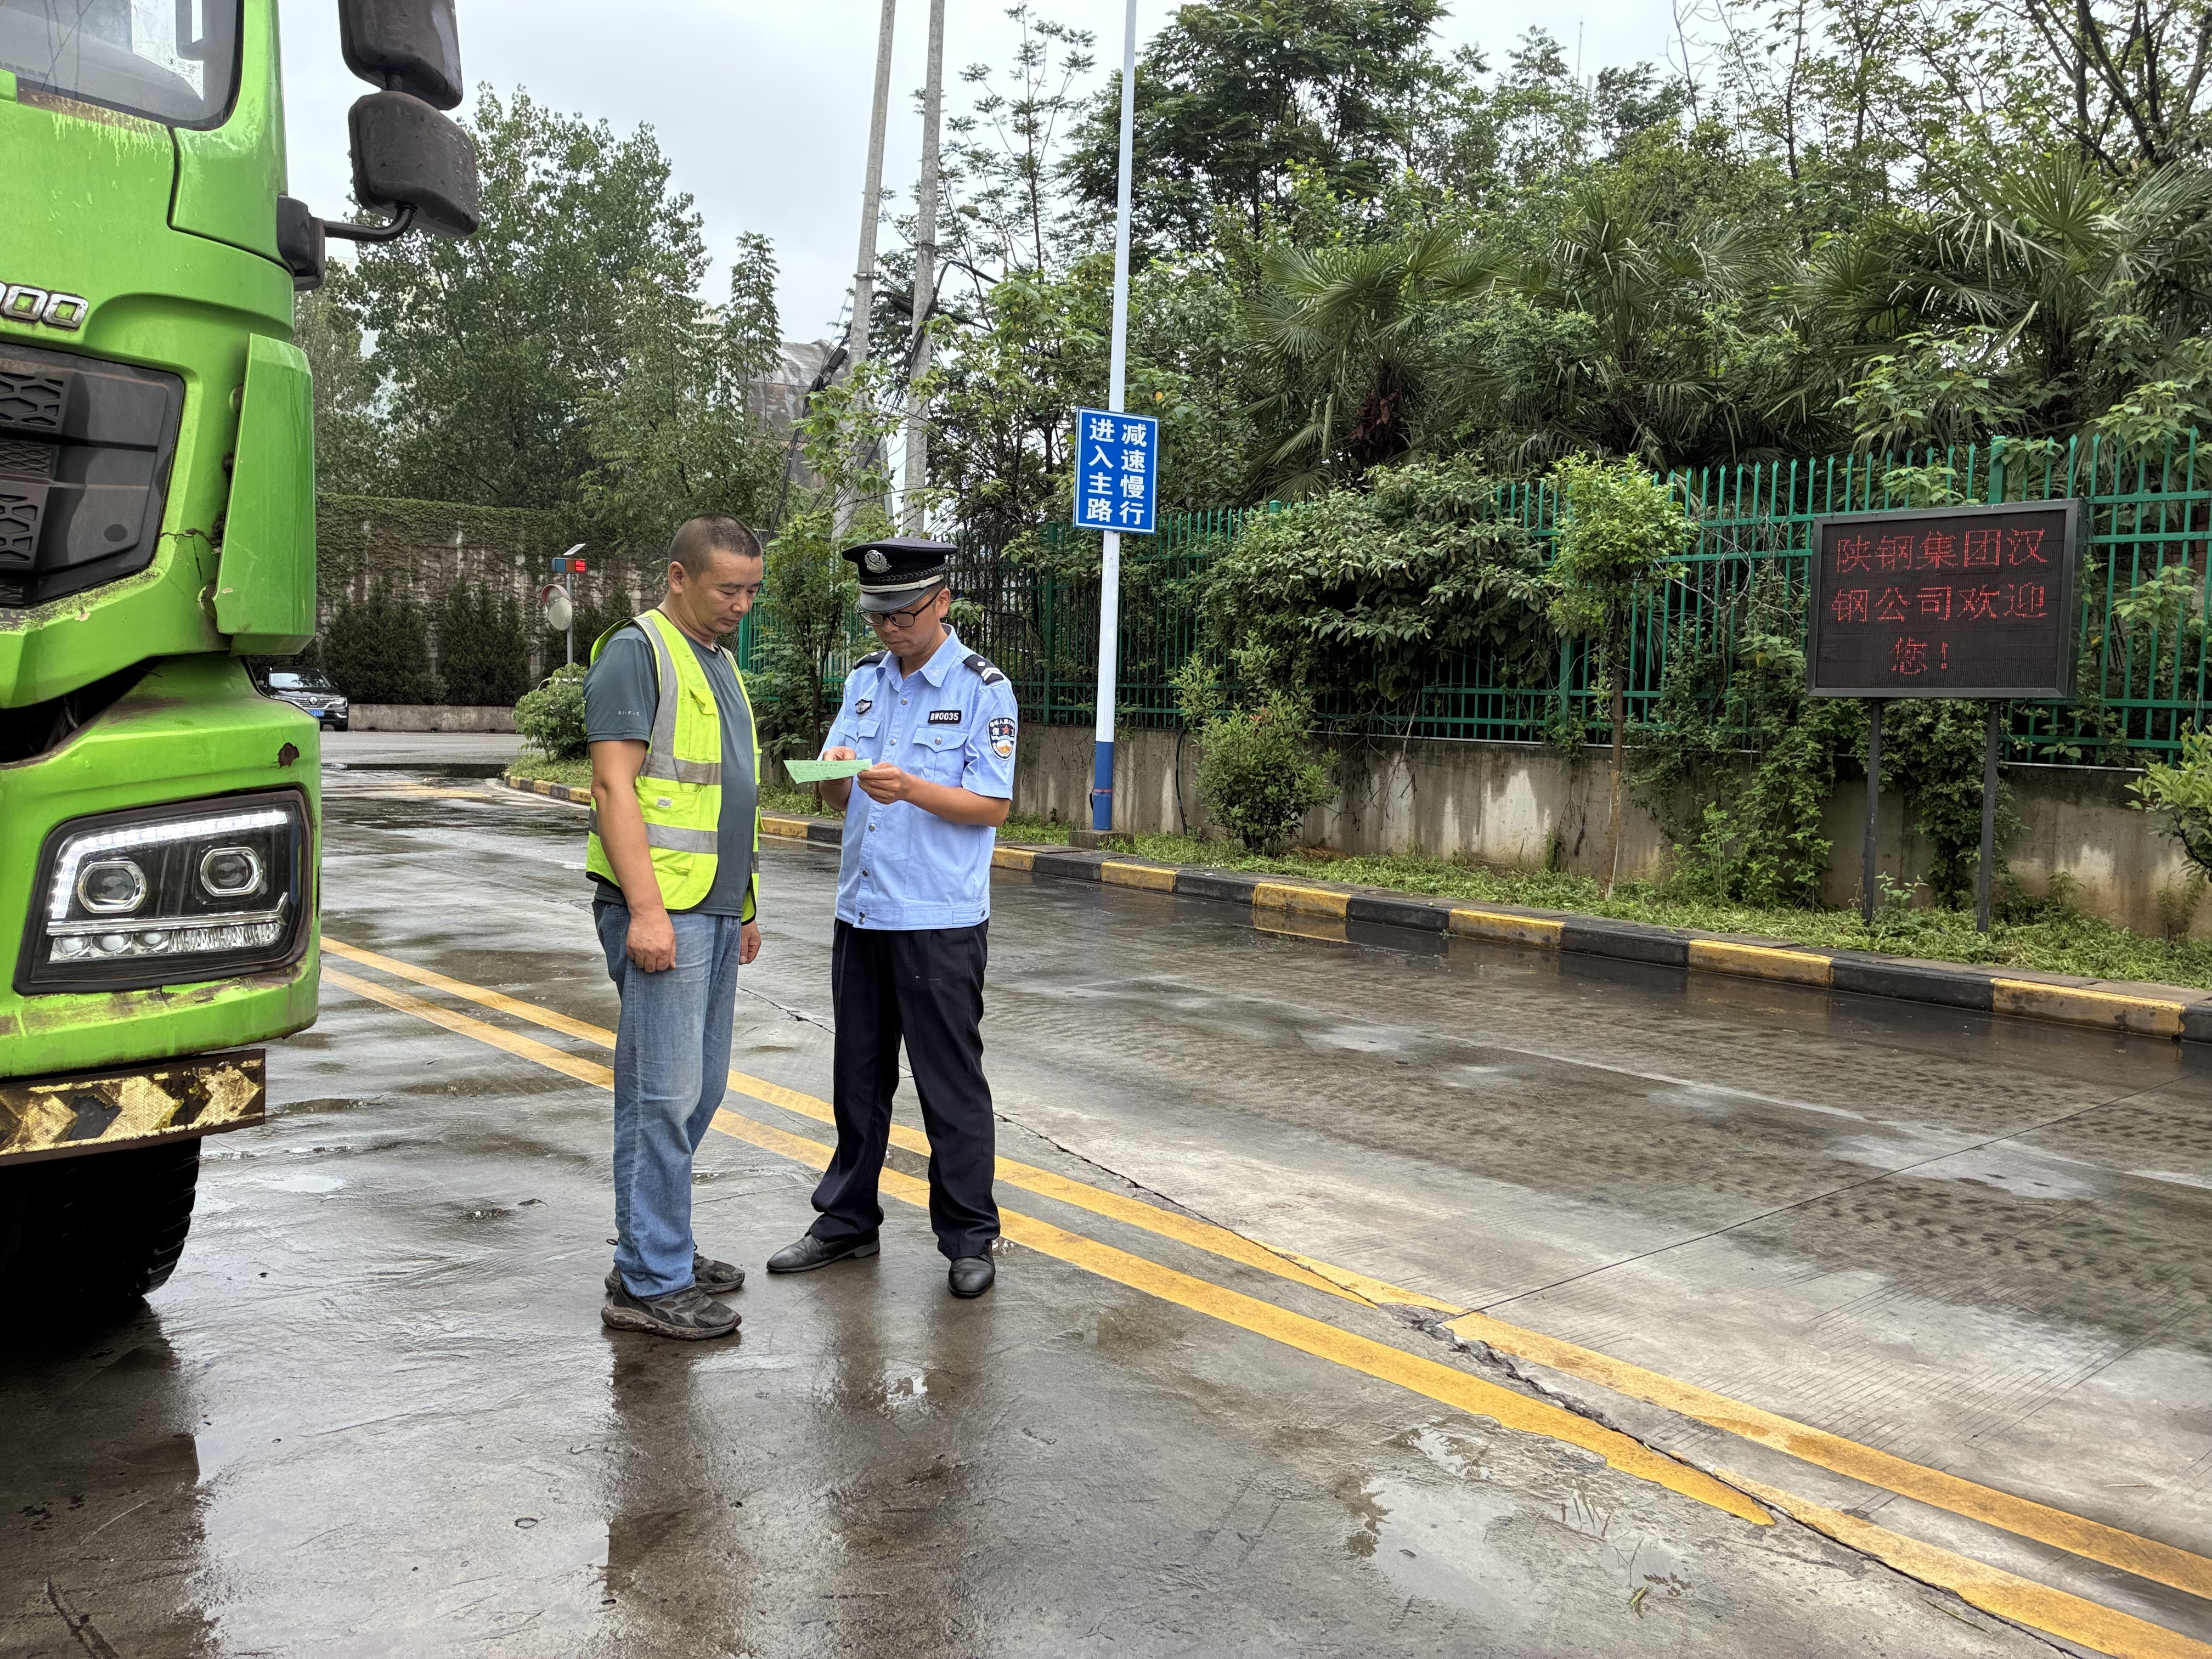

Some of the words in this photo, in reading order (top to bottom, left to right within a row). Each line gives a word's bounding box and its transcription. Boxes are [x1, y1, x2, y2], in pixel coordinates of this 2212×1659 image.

[0, 282, 89, 329] 00
[1086, 417, 1115, 522] 进入主路
[1119, 423, 1147, 525] 减速慢行
[1837, 528, 2047, 573] 陕钢集团汉
[1831, 583, 2047, 623] 钢公司欢迎
